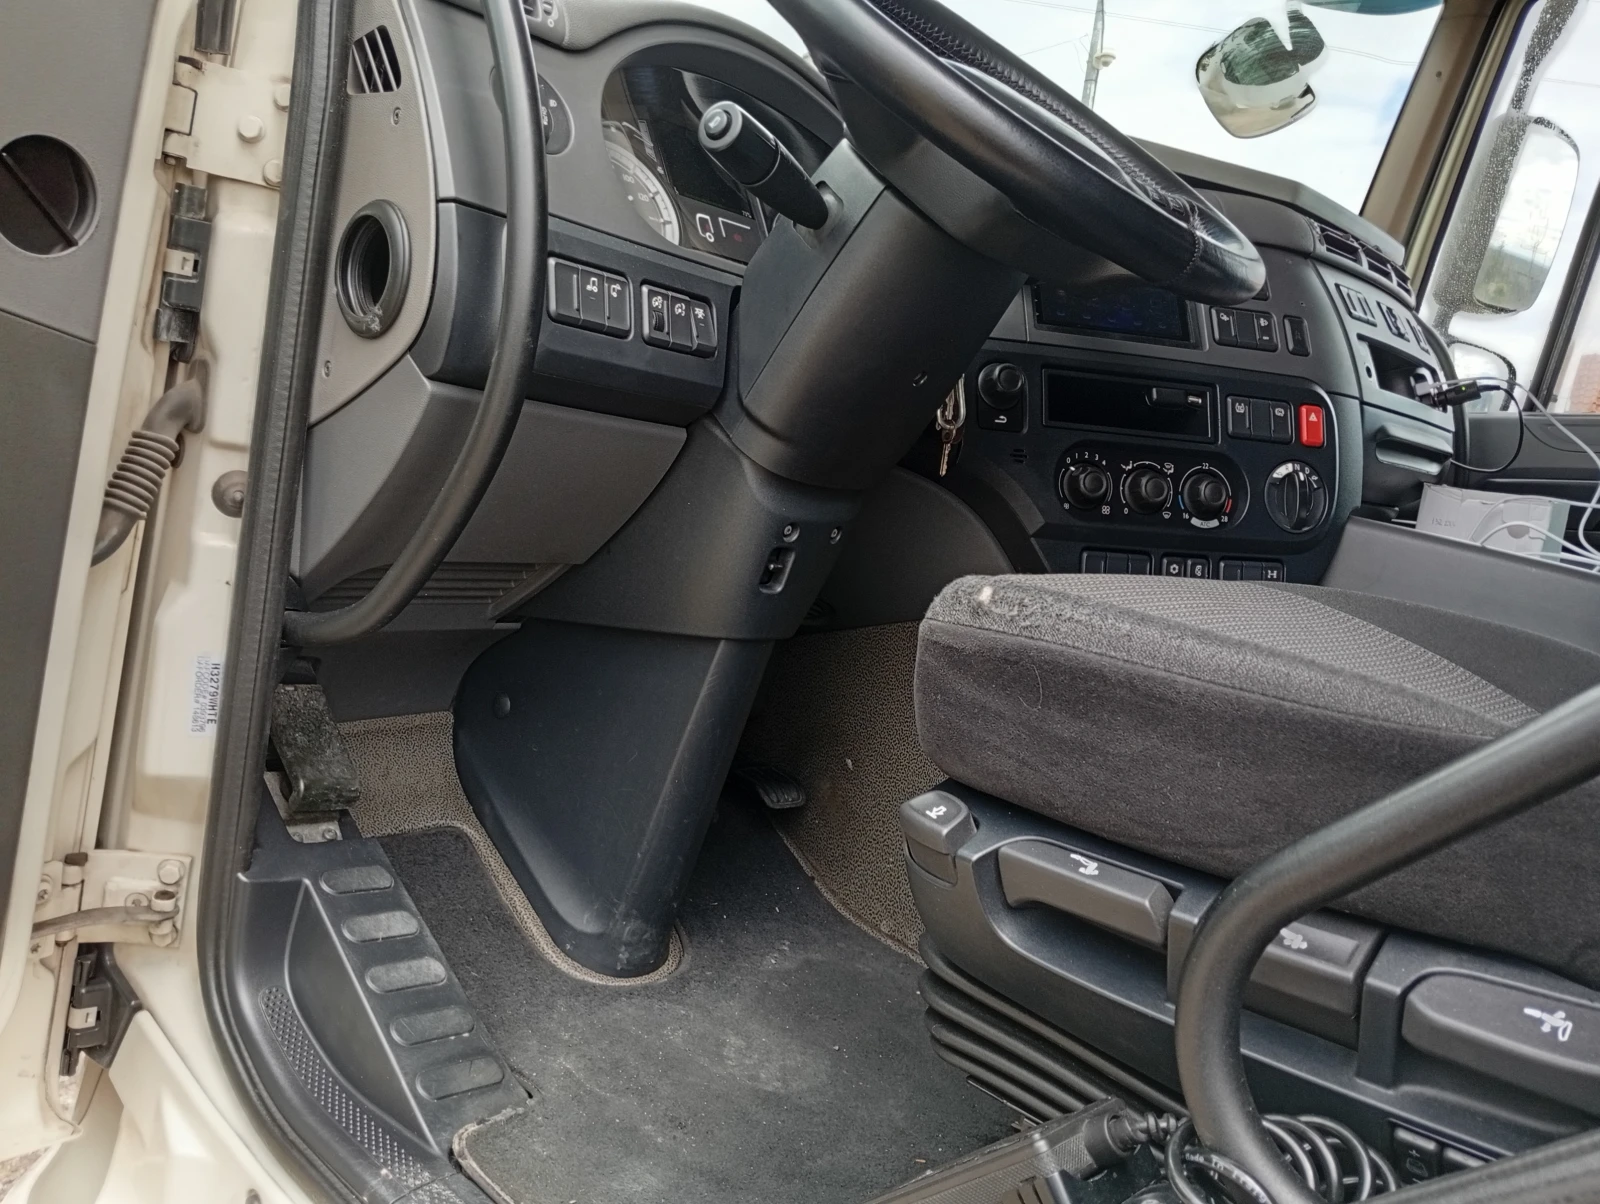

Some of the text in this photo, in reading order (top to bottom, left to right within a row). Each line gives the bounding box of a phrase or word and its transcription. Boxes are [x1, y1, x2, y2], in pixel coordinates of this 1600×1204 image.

[1084, 451, 1089, 459] 2
[1202, 462, 1209, 470] 22
[1294, 463, 1300, 471] N
